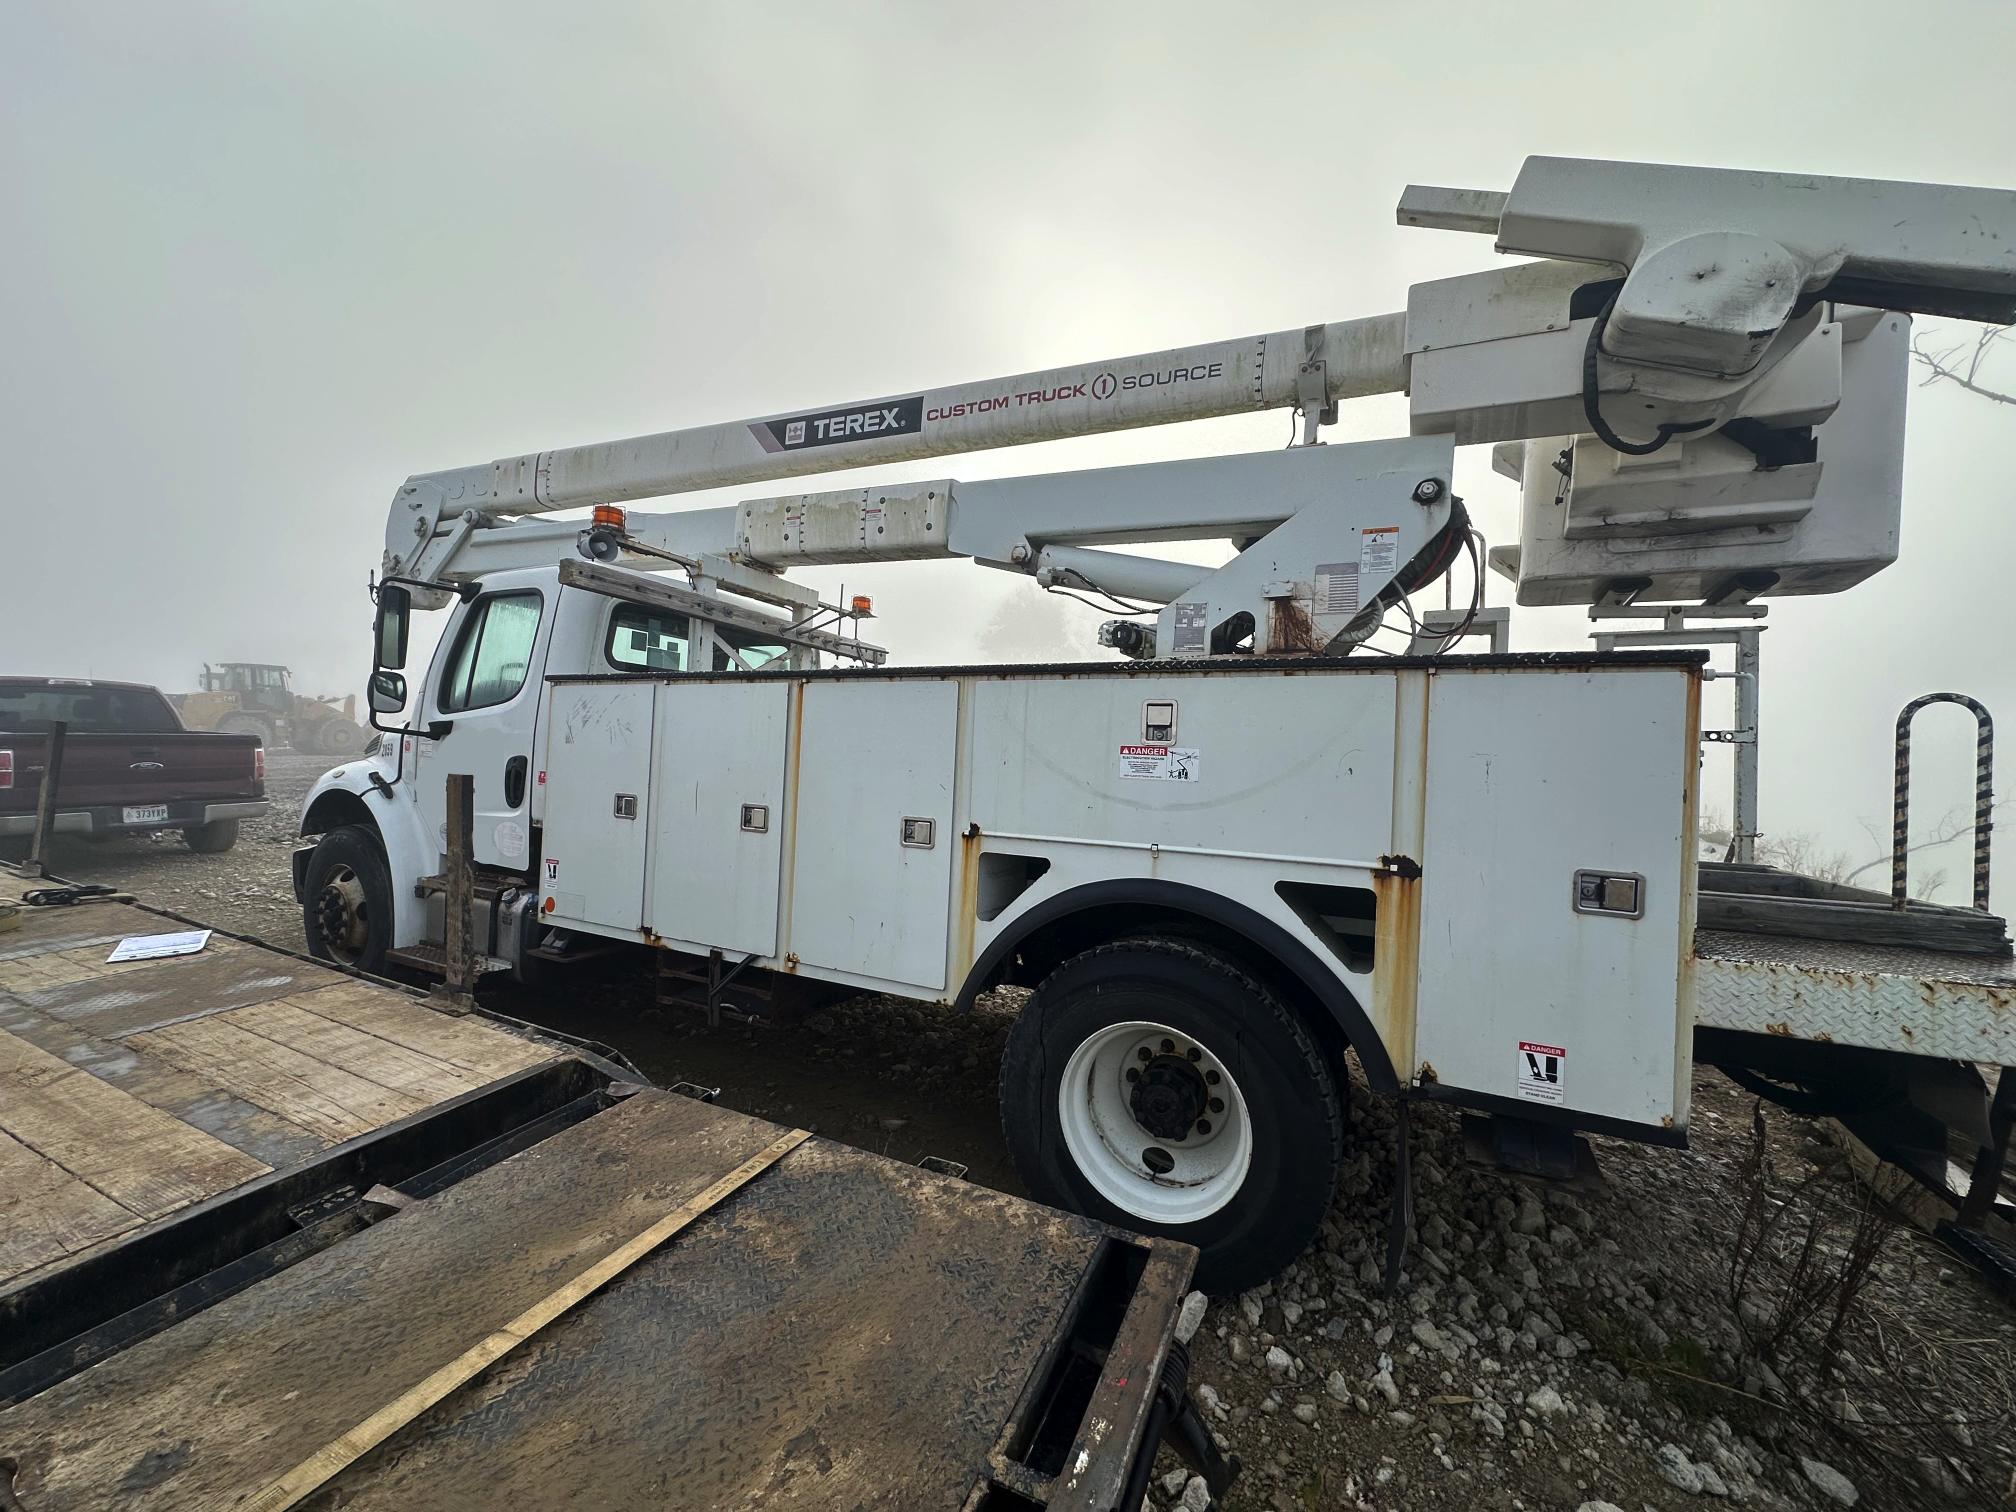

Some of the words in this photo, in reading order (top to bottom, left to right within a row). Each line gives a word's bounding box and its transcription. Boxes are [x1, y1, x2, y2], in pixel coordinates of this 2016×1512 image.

[926, 396, 1010, 421] CUSTOM
[1014, 383, 1088, 406] TRUCK
[1122, 362, 1223, 390] SOURCE
[814, 407, 900, 439] TEREX
[1130, 747, 1165, 755] DANGER
[1531, 1045, 1561, 1055] DANGER
